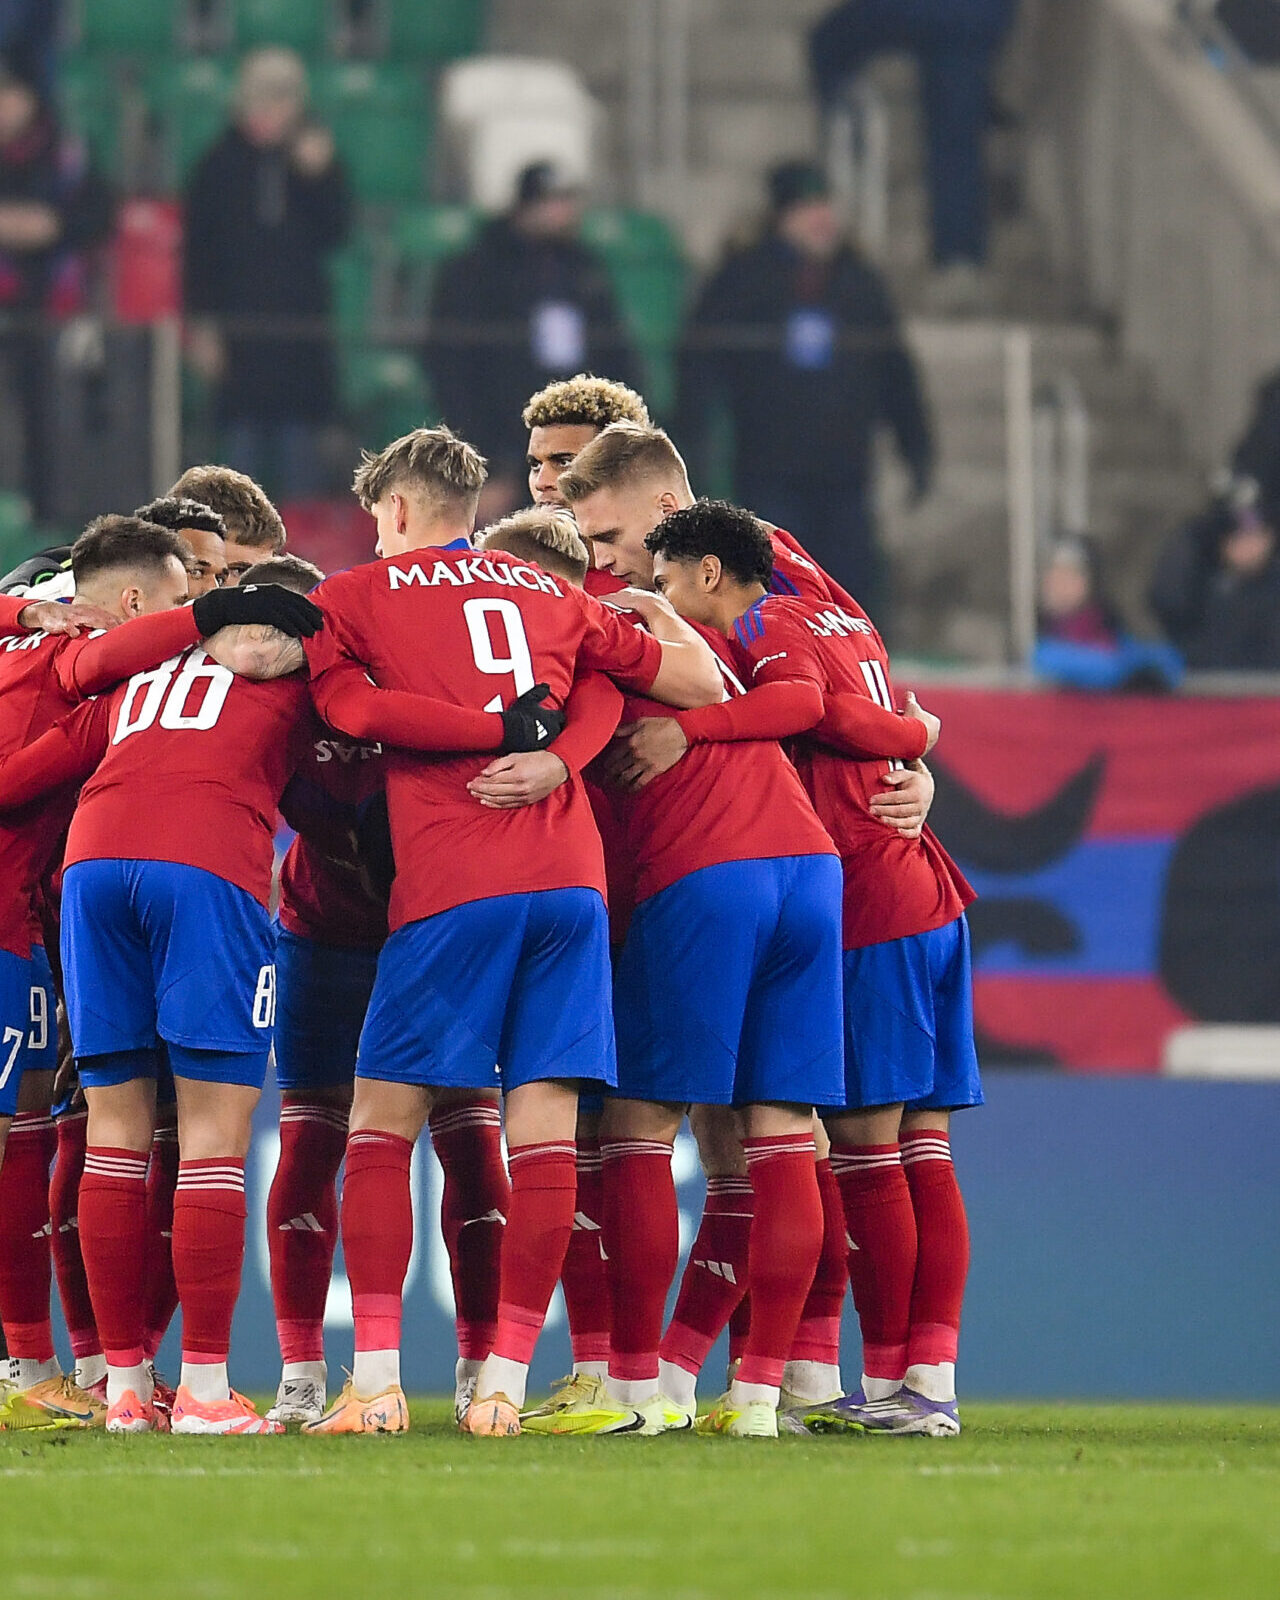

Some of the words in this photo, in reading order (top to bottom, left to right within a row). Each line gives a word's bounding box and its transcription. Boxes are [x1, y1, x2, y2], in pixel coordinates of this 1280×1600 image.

[387, 557, 565, 598] MAKUCH
[462, 597, 536, 713] 9
[28, 986, 48, 1049] 9
